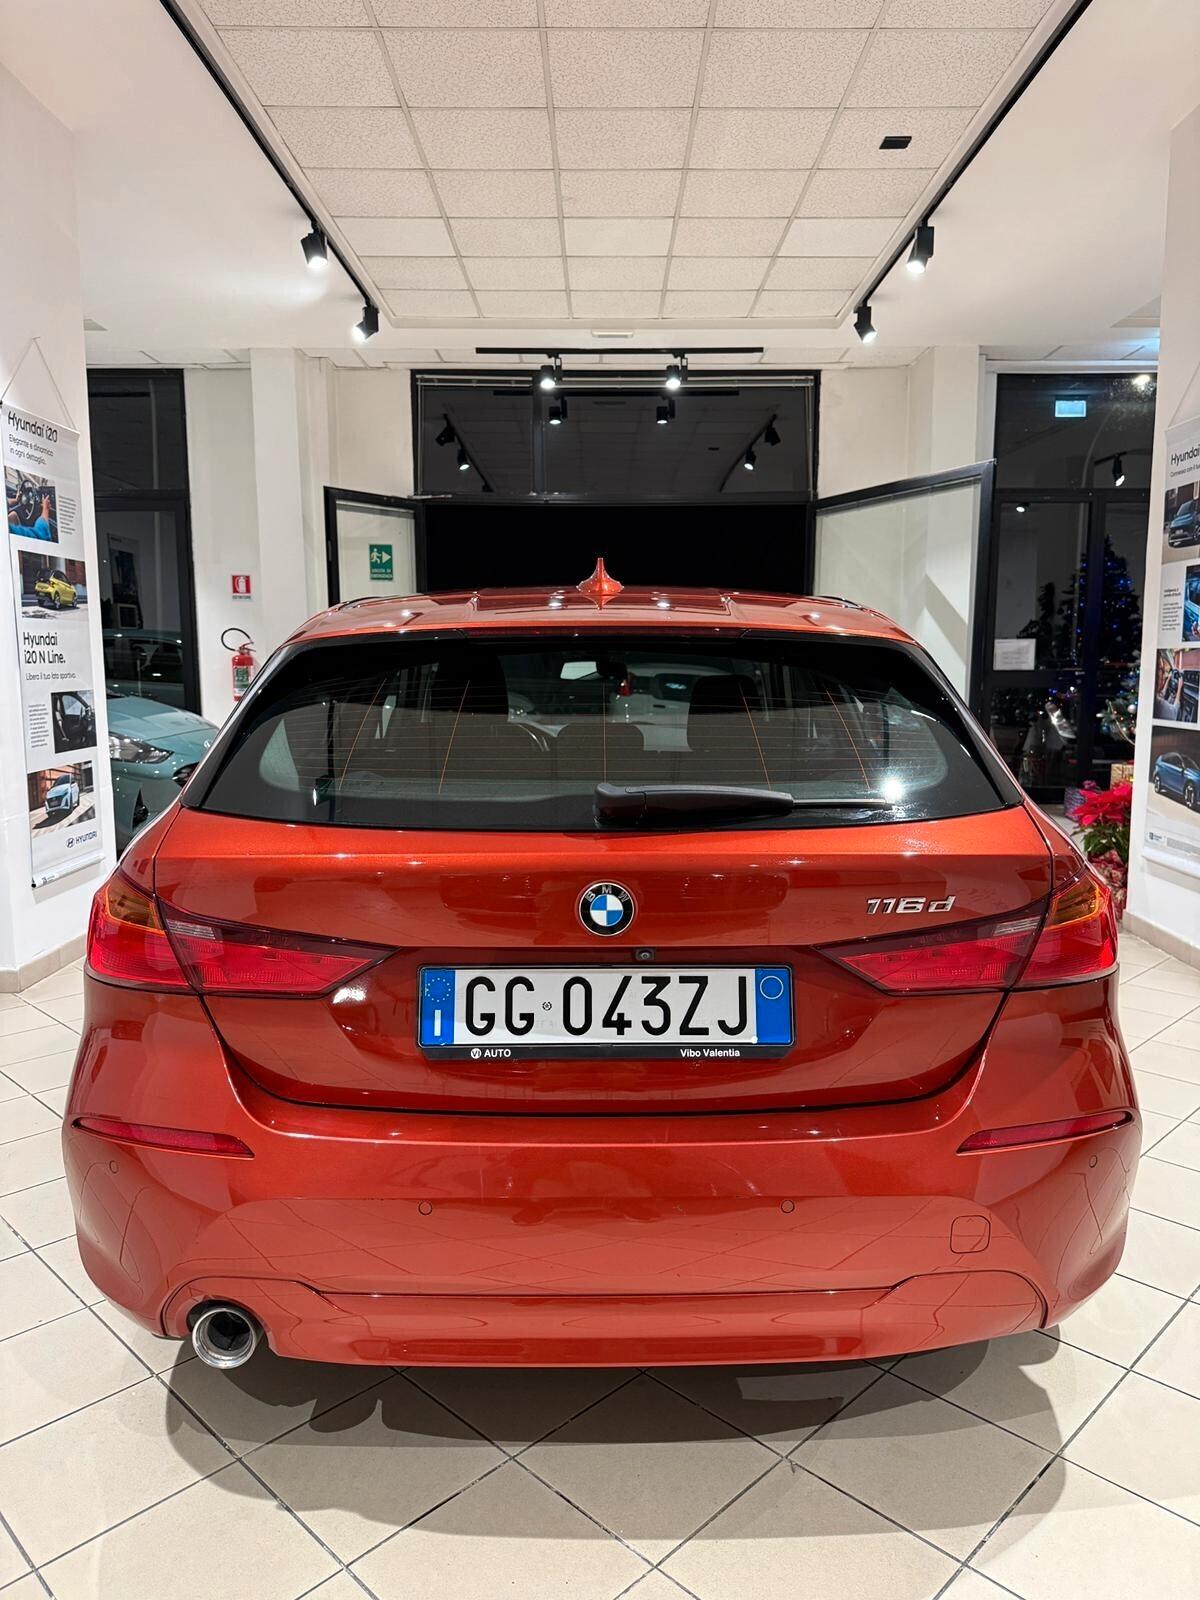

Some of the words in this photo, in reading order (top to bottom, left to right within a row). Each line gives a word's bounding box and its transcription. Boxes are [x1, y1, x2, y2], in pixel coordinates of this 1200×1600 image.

[8, 410, 44, 438] Hyundai
[45, 425, 58, 443] i20
[23, 631, 58, 649] Hyundai
[24, 650, 37, 664] i20
[39, 650, 46, 664] N
[47, 650, 66, 664] Line.
[75, 831, 97, 844] HYUNDAI
[584, 884, 630, 903] BMW
[867, 895, 956, 914] 116d
[484, 1049, 511, 1058] AUTO
[680, 1049, 701, 1057] Vibo
[703, 1049, 740, 1057] Valentia
